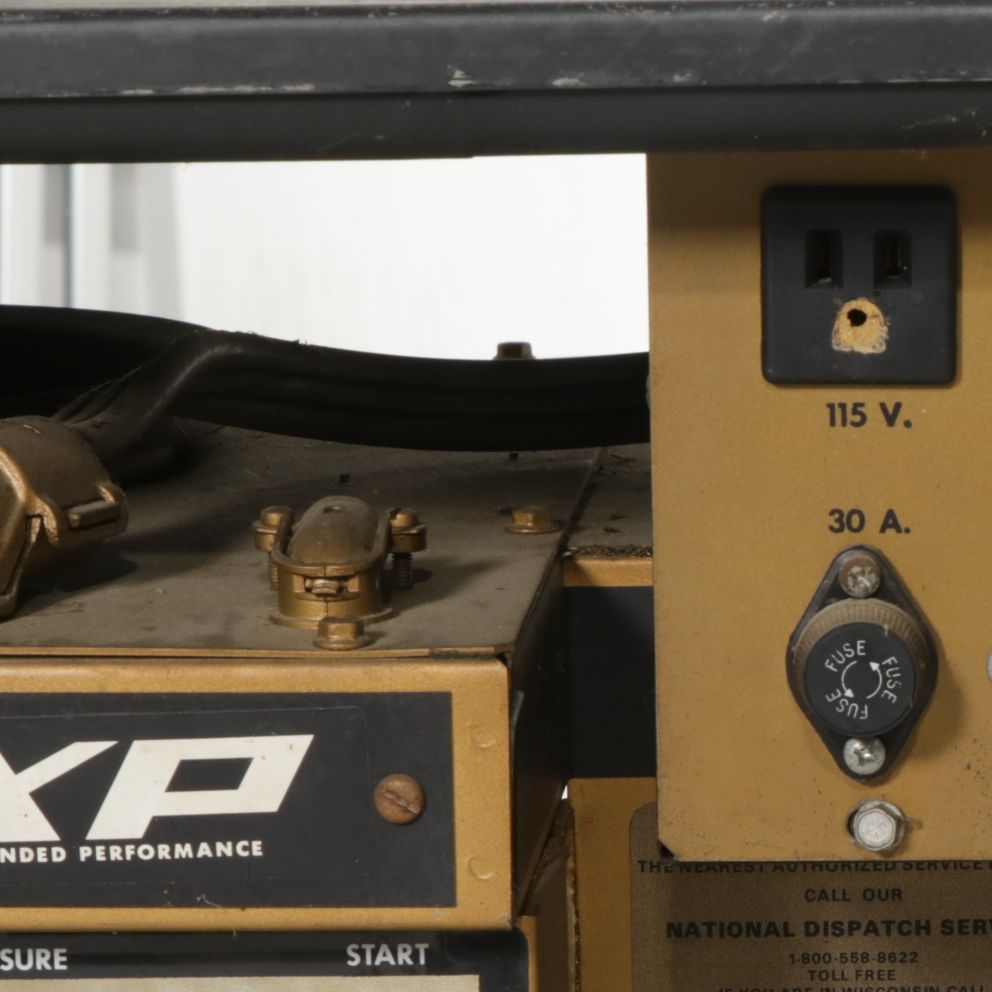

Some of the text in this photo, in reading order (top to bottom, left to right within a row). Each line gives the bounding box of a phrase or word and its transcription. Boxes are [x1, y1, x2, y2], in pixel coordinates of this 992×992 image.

[827, 402, 912, 428] 115 V.
[828, 509, 911, 534] 30 A.
[824, 640, 866, 672] FUSE
[882, 656, 902, 704] FUSE
[825, 688, 868, 720] FUSE
[80, 840, 263, 862] PERFORMANCE
[638, 860, 672, 873] THE
[680, 862, 765, 873] NEAREST
[772, 861, 896, 872] AUTHORIZED
[902, 860, 983, 871] SERVICE
[804, 888, 902, 902] CALL OUR
[666, 920, 795, 939] NATIONAL
[804, 918, 930, 937] DISPATCH
[0, 948, 68, 971] SURE
[346, 943, 429, 967] START
[788, 951, 918, 964] 1-800-558-8622
[808, 969, 895, 981] TOLL FREE
